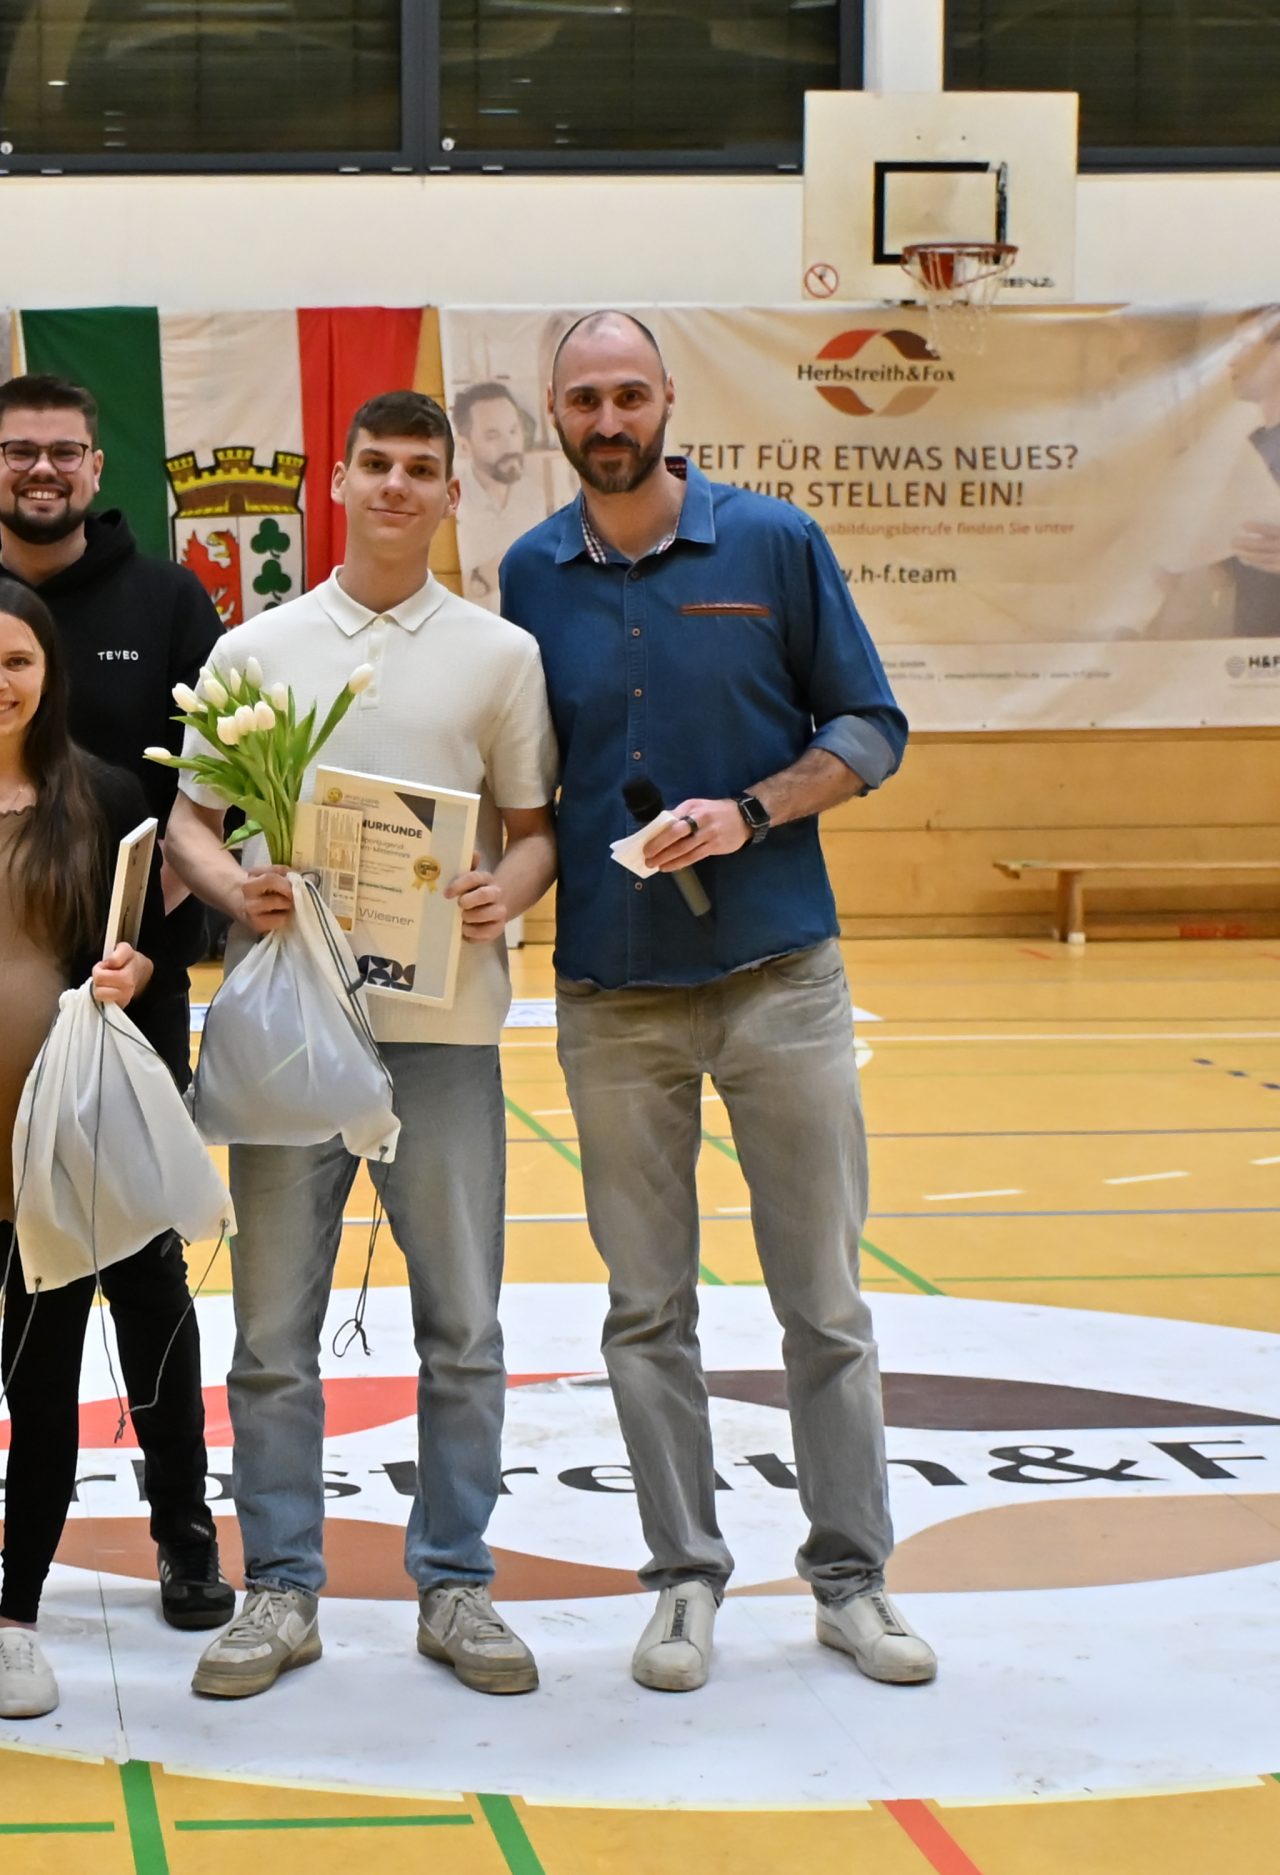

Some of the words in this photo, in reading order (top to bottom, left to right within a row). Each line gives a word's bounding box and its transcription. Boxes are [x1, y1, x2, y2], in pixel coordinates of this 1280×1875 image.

[796, 363, 956, 382] Herbstreith&Fox
[757, 439, 822, 471] FÜR
[834, 445, 943, 471] ETWAS
[955, 444, 1079, 471] NEUES?
[807, 482, 947, 508] STELLEN
[959, 481, 1024, 508] EIN!
[956, 521, 1004, 535] finden
[1008, 522, 1030, 535] Sie
[1034, 522, 1074, 535] unter
[358, 907, 415, 926] Wiesner
